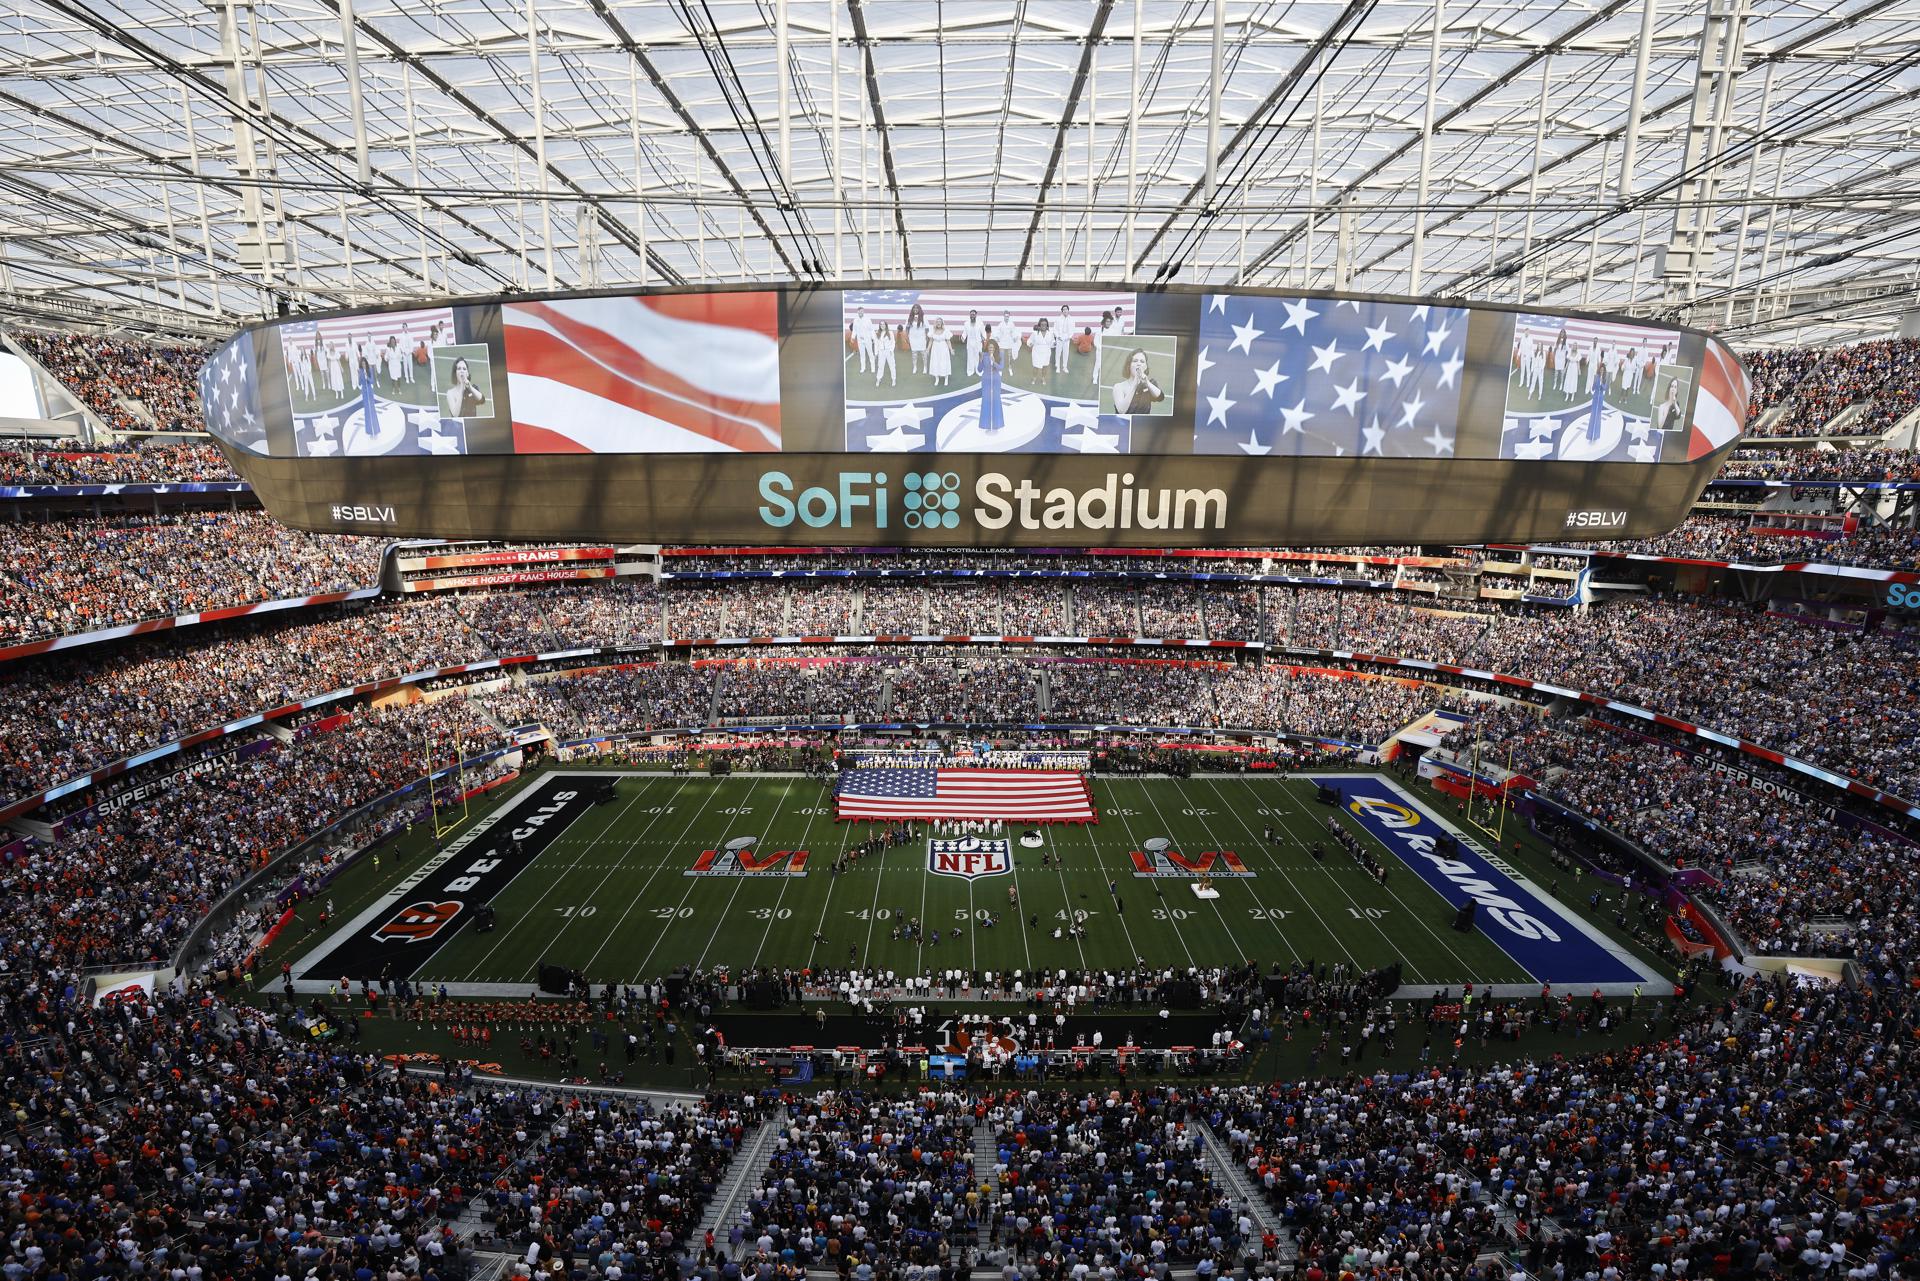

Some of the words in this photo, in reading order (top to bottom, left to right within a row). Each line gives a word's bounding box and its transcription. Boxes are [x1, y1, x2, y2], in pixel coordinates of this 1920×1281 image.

[759, 471, 888, 529] SoFi
[974, 471, 1228, 529] Stadium
[332, 505, 396, 522] #SBLVI
[1566, 511, 1627, 527] #SBLVI
[517, 551, 560, 562] RAMS
[444, 576, 479, 588] WHOSE
[480, 574, 517, 584] HOUSE?
[519, 572, 545, 582] RAMS
[546, 570, 578, 580] HOUSE!
[1692, 755, 1749, 784] SUPER
[1750, 777, 1803, 806] BOW
[97, 782, 158, 817] SUPER
[443, 790, 578, 893] BEGALS
[389, 887, 407, 896] IT
[405, 857, 448, 884] TAKES
[445, 840, 471, 854] ALL
[466, 828, 483, 837] OF
[480, 816, 499, 826] US
[937, 853, 1003, 874] NFL
[1394, 831, 1562, 943] RAMS
[560, 906, 598, 918] 10
[656, 906, 695, 919] 20
[755, 907, 793, 920] 30
[855, 908, 891, 920] 40
[953, 908, 990, 920] 50
[1053, 908, 1089, 920] 40
[1151, 908, 1190, 920] 30
[1248, 908, 1288, 920] 20
[1345, 907, 1383, 919] 10
